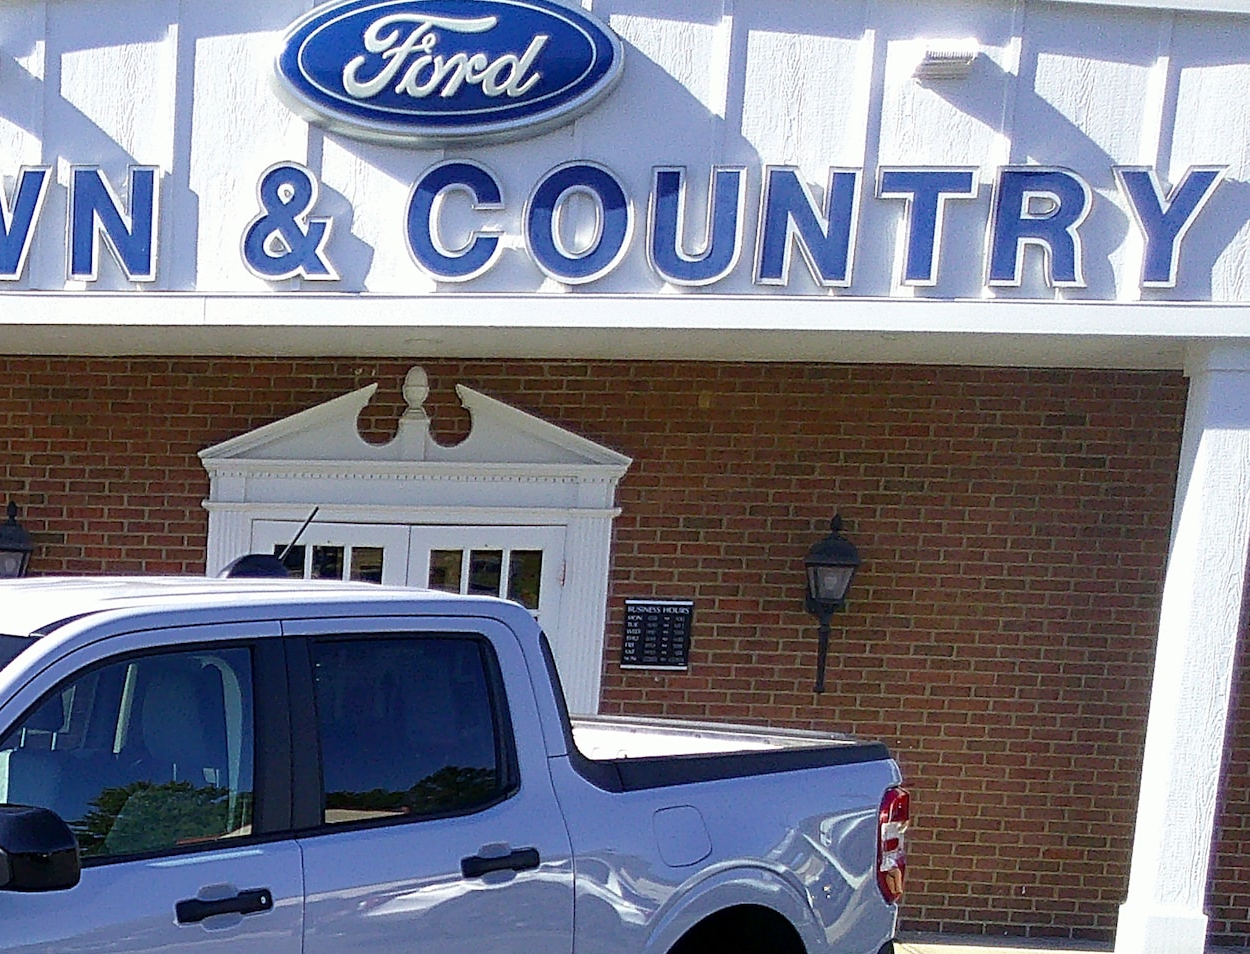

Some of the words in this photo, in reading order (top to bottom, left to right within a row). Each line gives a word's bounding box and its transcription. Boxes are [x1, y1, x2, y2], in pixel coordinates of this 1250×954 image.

[343, 13, 548, 98] Ford
[243, 159, 340, 283] &
[403, 158, 1230, 289] COUNTRY
